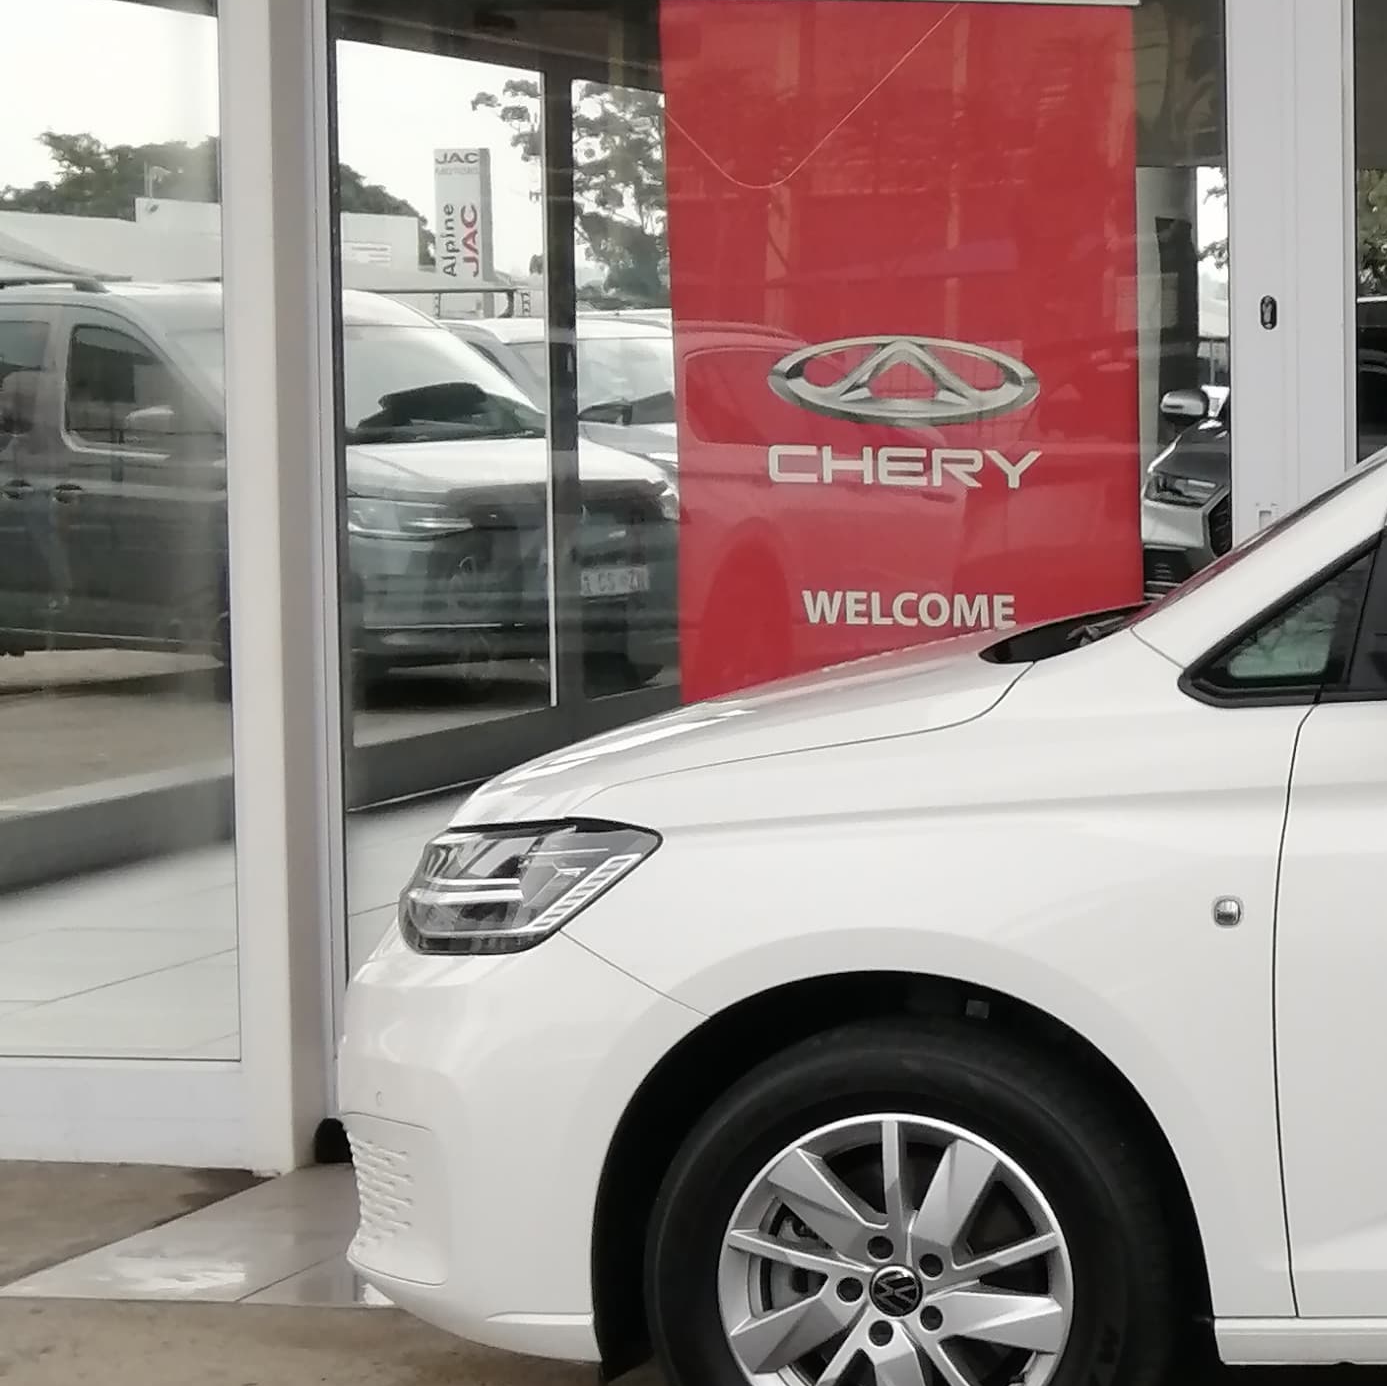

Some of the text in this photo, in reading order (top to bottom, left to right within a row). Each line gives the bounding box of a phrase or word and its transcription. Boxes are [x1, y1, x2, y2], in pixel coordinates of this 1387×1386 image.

[435, 152, 479, 164] JAC
[442, 204, 460, 277] Alpine
[460, 204, 479, 277] JAC
[768, 444, 1042, 488] CHERY
[802, 590, 1017, 628] WELCOME
